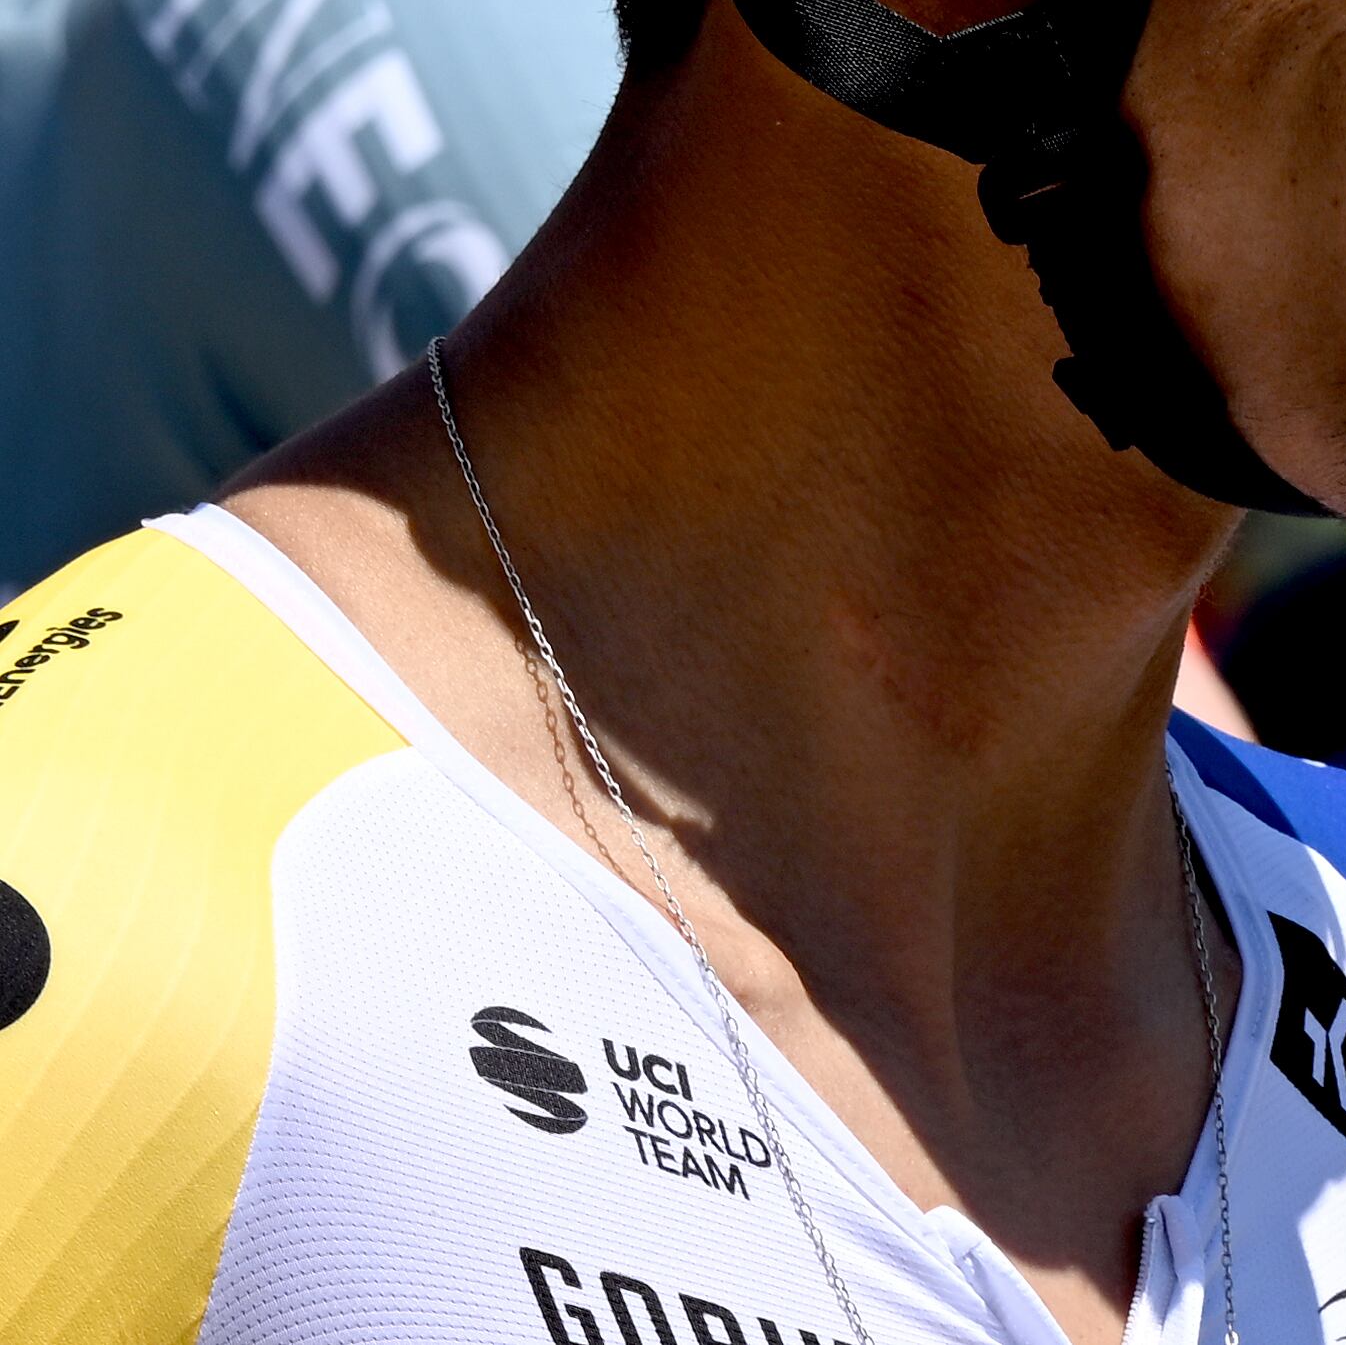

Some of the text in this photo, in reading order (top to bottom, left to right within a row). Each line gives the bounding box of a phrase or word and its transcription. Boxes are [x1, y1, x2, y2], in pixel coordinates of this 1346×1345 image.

[0, 607, 123, 707] nergies
[601, 1037, 694, 1103] UCI
[611, 1081, 772, 1168] WORLD
[622, 1125, 751, 1201] TEAM
